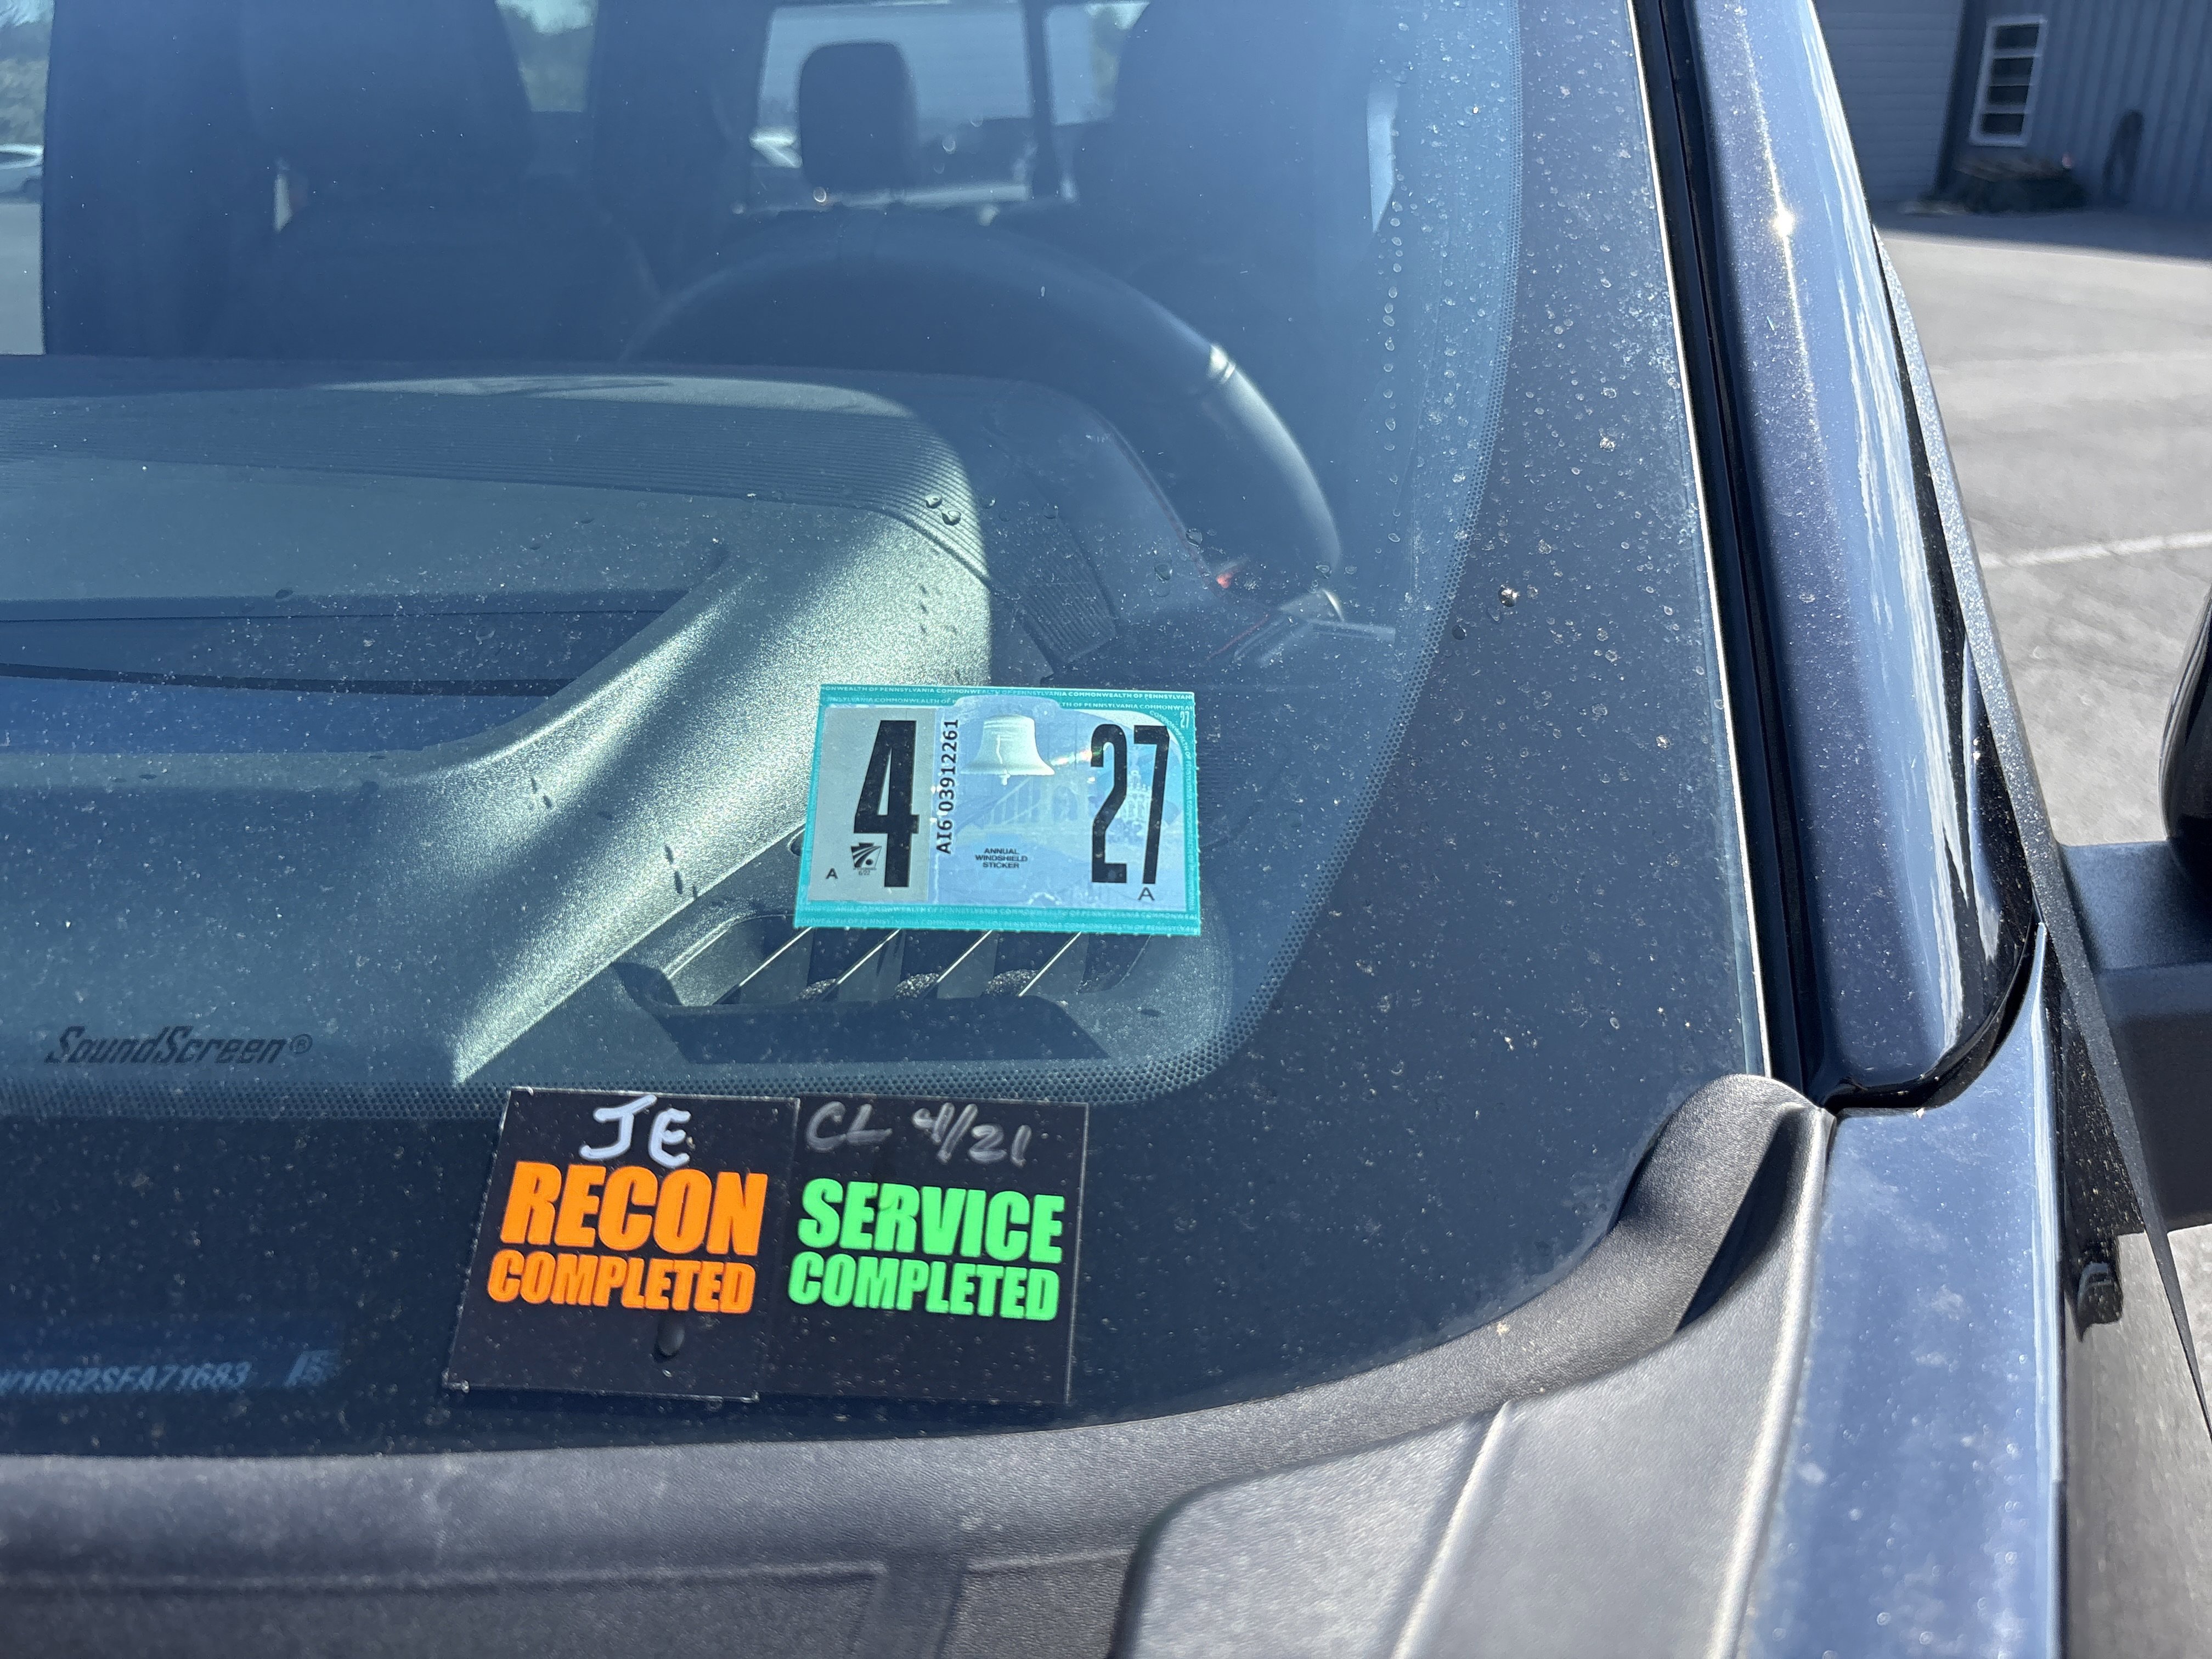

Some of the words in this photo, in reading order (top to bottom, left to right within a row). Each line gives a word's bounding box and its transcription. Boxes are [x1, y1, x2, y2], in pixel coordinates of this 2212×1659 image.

[1180, 710, 1189, 729] 27
[854, 720, 919, 888] 4
[1090, 723, 1170, 884] 27
[825, 868, 839, 879] A
[1137, 887, 1155, 901] A
[500, 1161, 769, 1256] RECON
[798, 1178, 1065, 1264] SERVICE
[487, 1249, 756, 1314] COMPLETED
[788, 1251, 1060, 1321] COMPLETED
